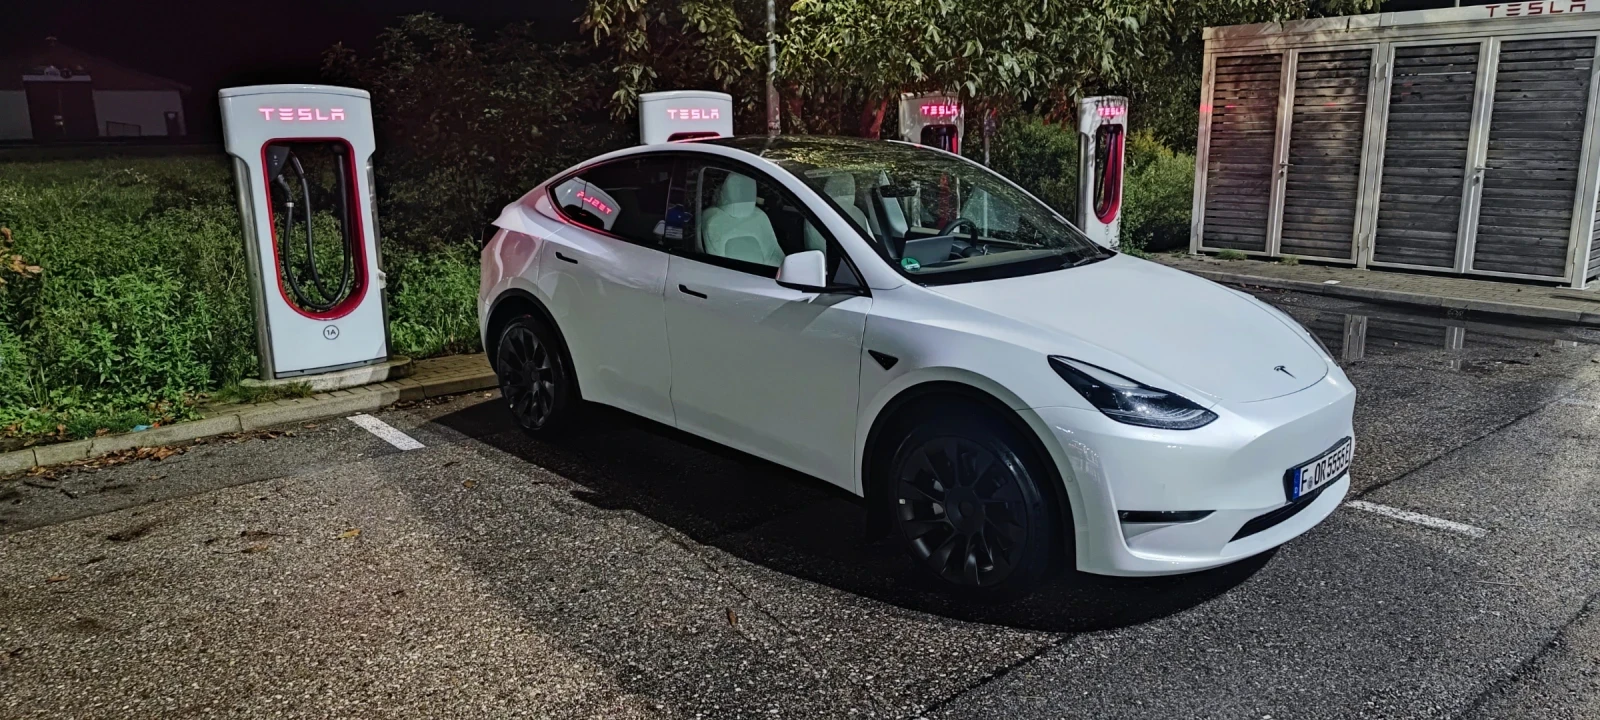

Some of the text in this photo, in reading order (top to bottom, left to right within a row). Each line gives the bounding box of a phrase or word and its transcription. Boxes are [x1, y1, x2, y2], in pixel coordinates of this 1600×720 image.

[1485, 0, 1587, 18] TESLA
[258, 107, 345, 121] TESLA
[667, 108, 720, 120] TESLA
[921, 105, 959, 115] TESLA
[1098, 107, 1125, 116] TESLA
[1300, 468, 1309, 492] F
